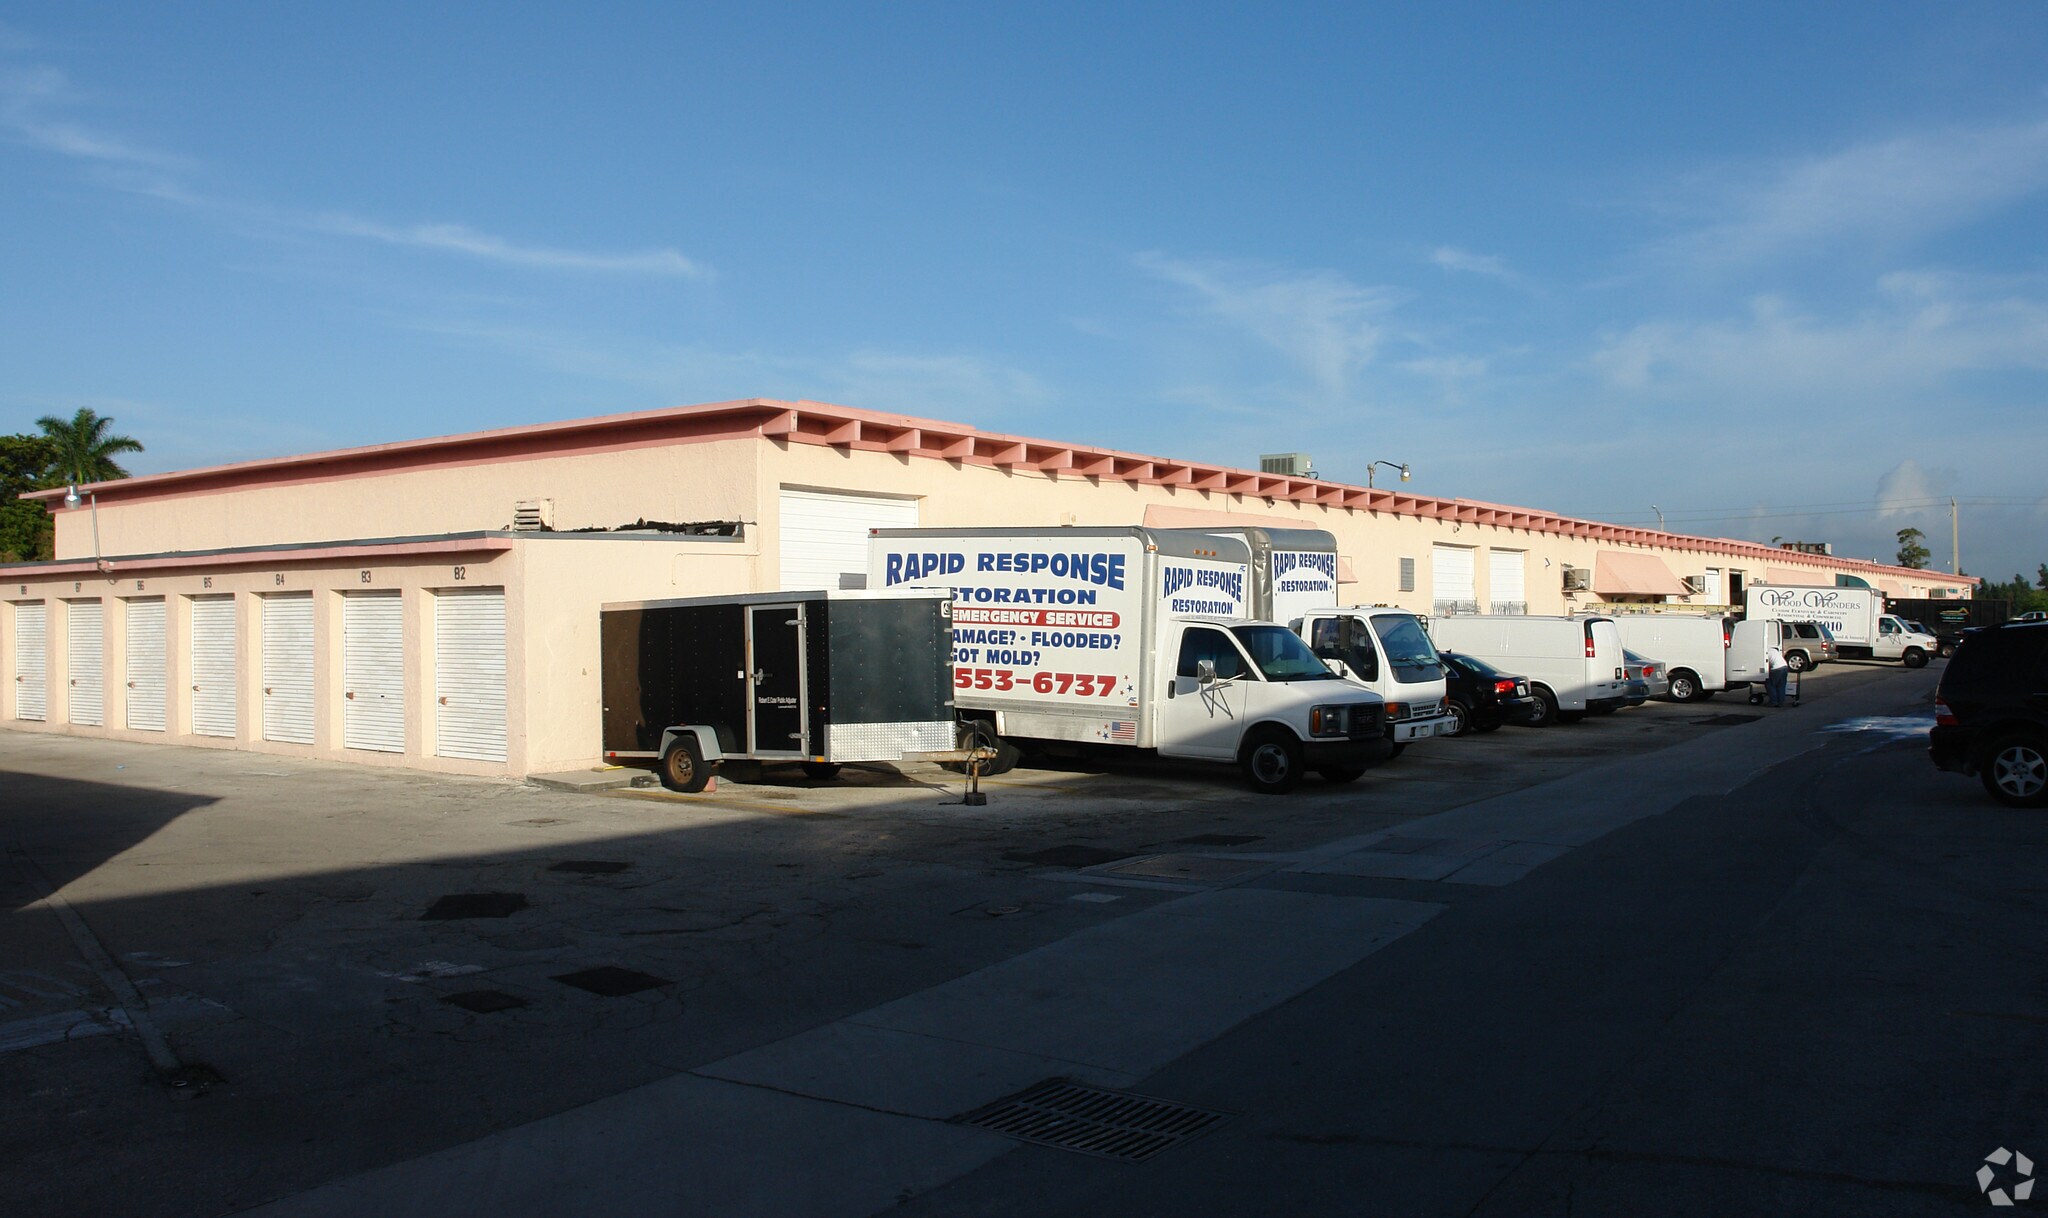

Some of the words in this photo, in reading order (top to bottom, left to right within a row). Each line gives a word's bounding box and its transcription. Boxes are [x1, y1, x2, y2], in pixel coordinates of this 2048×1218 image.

[886, 553, 965, 586] RAPID
[977, 553, 1126, 591] RESPONSE
[1274, 553, 1296, 580] RAPID
[1299, 553, 1334, 581] RESPONSE
[1164, 566, 1193, 598] RAPID
[1197, 569, 1242, 602] RESPONSE
[1281, 580, 1328, 592] RESTORATION
[911, 587, 1097, 605] TORATION
[1172, 599, 1233, 615] RESTORATION
[953, 609, 1041, 624] EMERGENCY
[1045, 612, 1114, 627] SERVICE
[953, 628, 1017, 645] AMAGE?
[1031, 631, 1122, 650] FLOODED?
[986, 649, 1041, 666] MOLD?
[954, 667, 1117, 697] 553-6737
